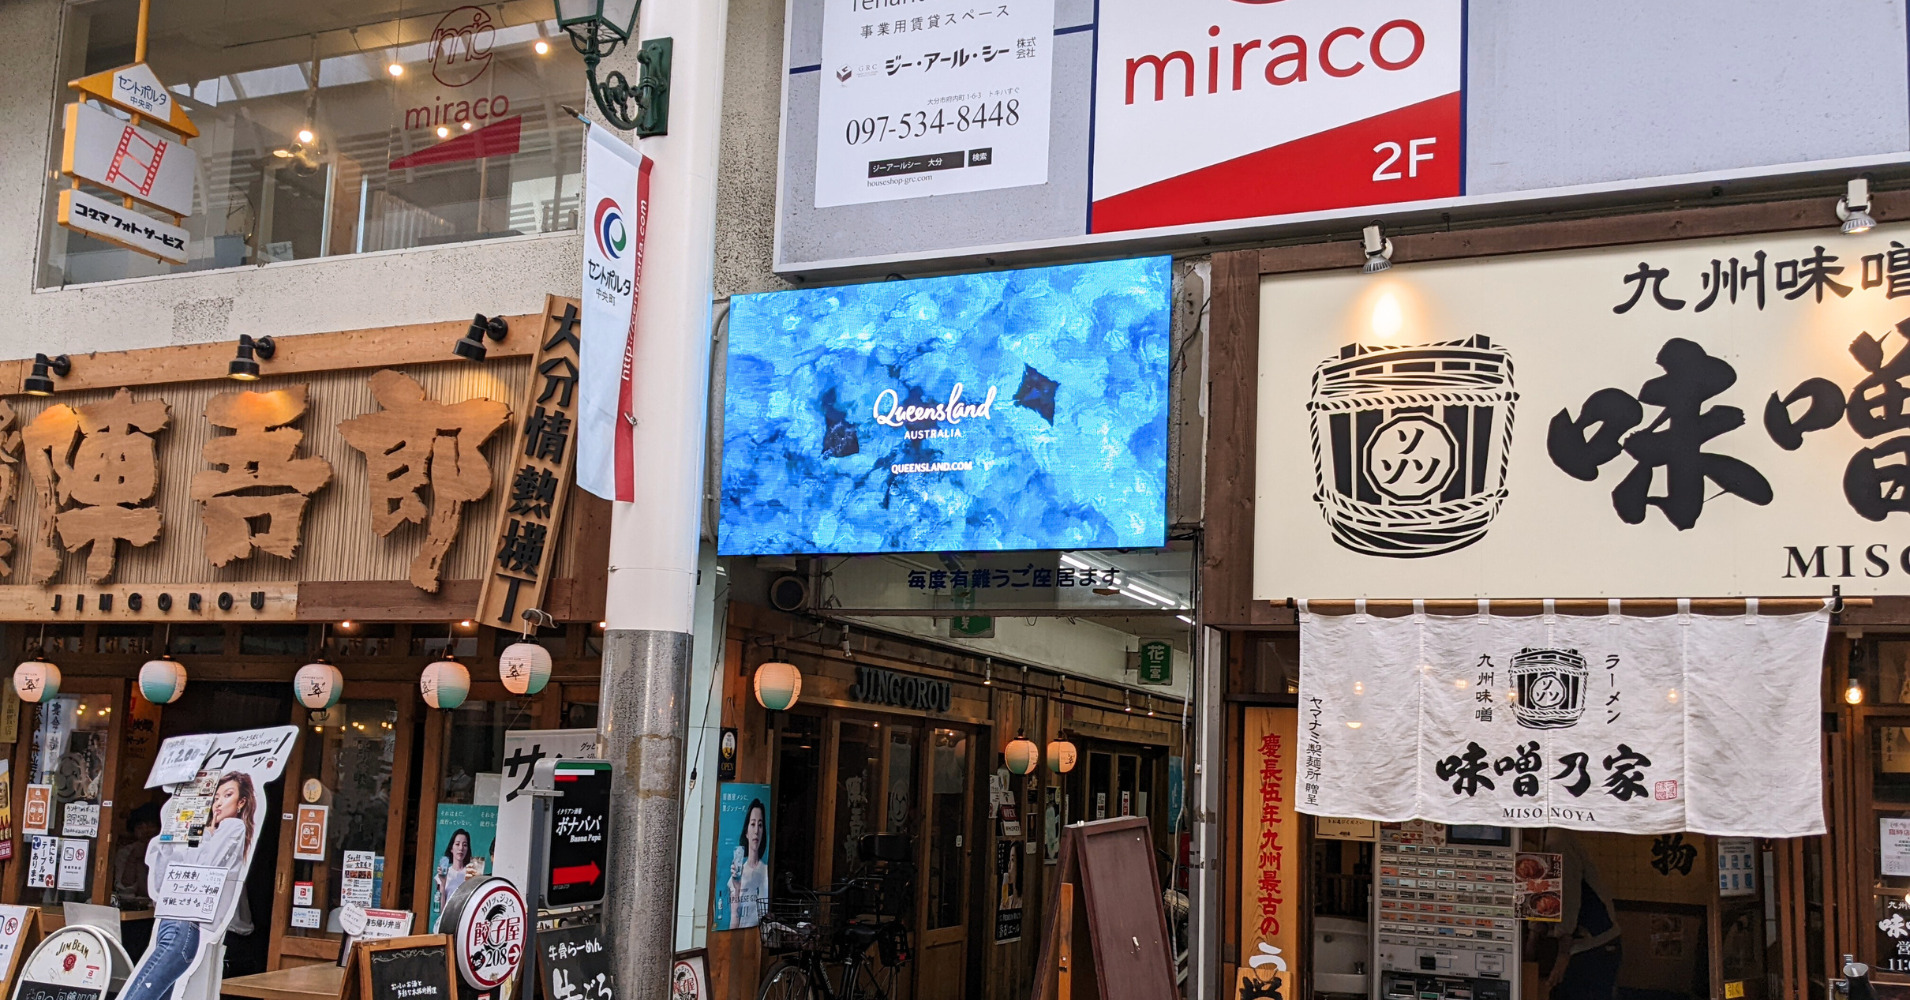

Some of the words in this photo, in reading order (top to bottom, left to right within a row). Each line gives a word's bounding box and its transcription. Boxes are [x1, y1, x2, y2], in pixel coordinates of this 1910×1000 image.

[860, 4, 1010, 39] 事業用賃貸スペース
[1124, 19, 1425, 105] miraco
[118, 75, 167, 106] セントポルタ
[130, 96, 153, 112] 中央町
[405, 95, 509, 130] miraco
[846, 99, 1020, 146] 097-534-8448
[928, 158, 943, 168] 大分
[1372, 137, 1437, 182] 2F
[588, 259, 631, 297] セントポルタ
[596, 288, 616, 307] 中央町
[873, 382, 997, 427] Queensland
[904, 428, 962, 440] AUSTRALIA
[496, 302, 581, 623] 大分情熱横丁
[891, 461, 973, 475] QUEENSLAND.COM
[908, 563, 1121, 590] 毎度有難うご座居ます
[51, 590, 266, 613] JINGOROU
[855, 667, 950, 712] JINGOROU
[1475, 653, 1495, 723] 九州味噌
[1605, 653, 1621, 725] ラーメン
[1436, 740, 1652, 802] 味噌乃家
[555, 815, 603, 836] ボナパパ
[1502, 807, 1543, 819] MISO
[1551, 807, 1595, 822] NOYA
[1258, 733, 1283, 936] 慶長伍年九州最古の
[474, 917, 521, 947] 餃子屋
[56, 942, 72, 956] JIM
[73, 938, 90, 960] BEAM
[485, 947, 507, 968] 208
